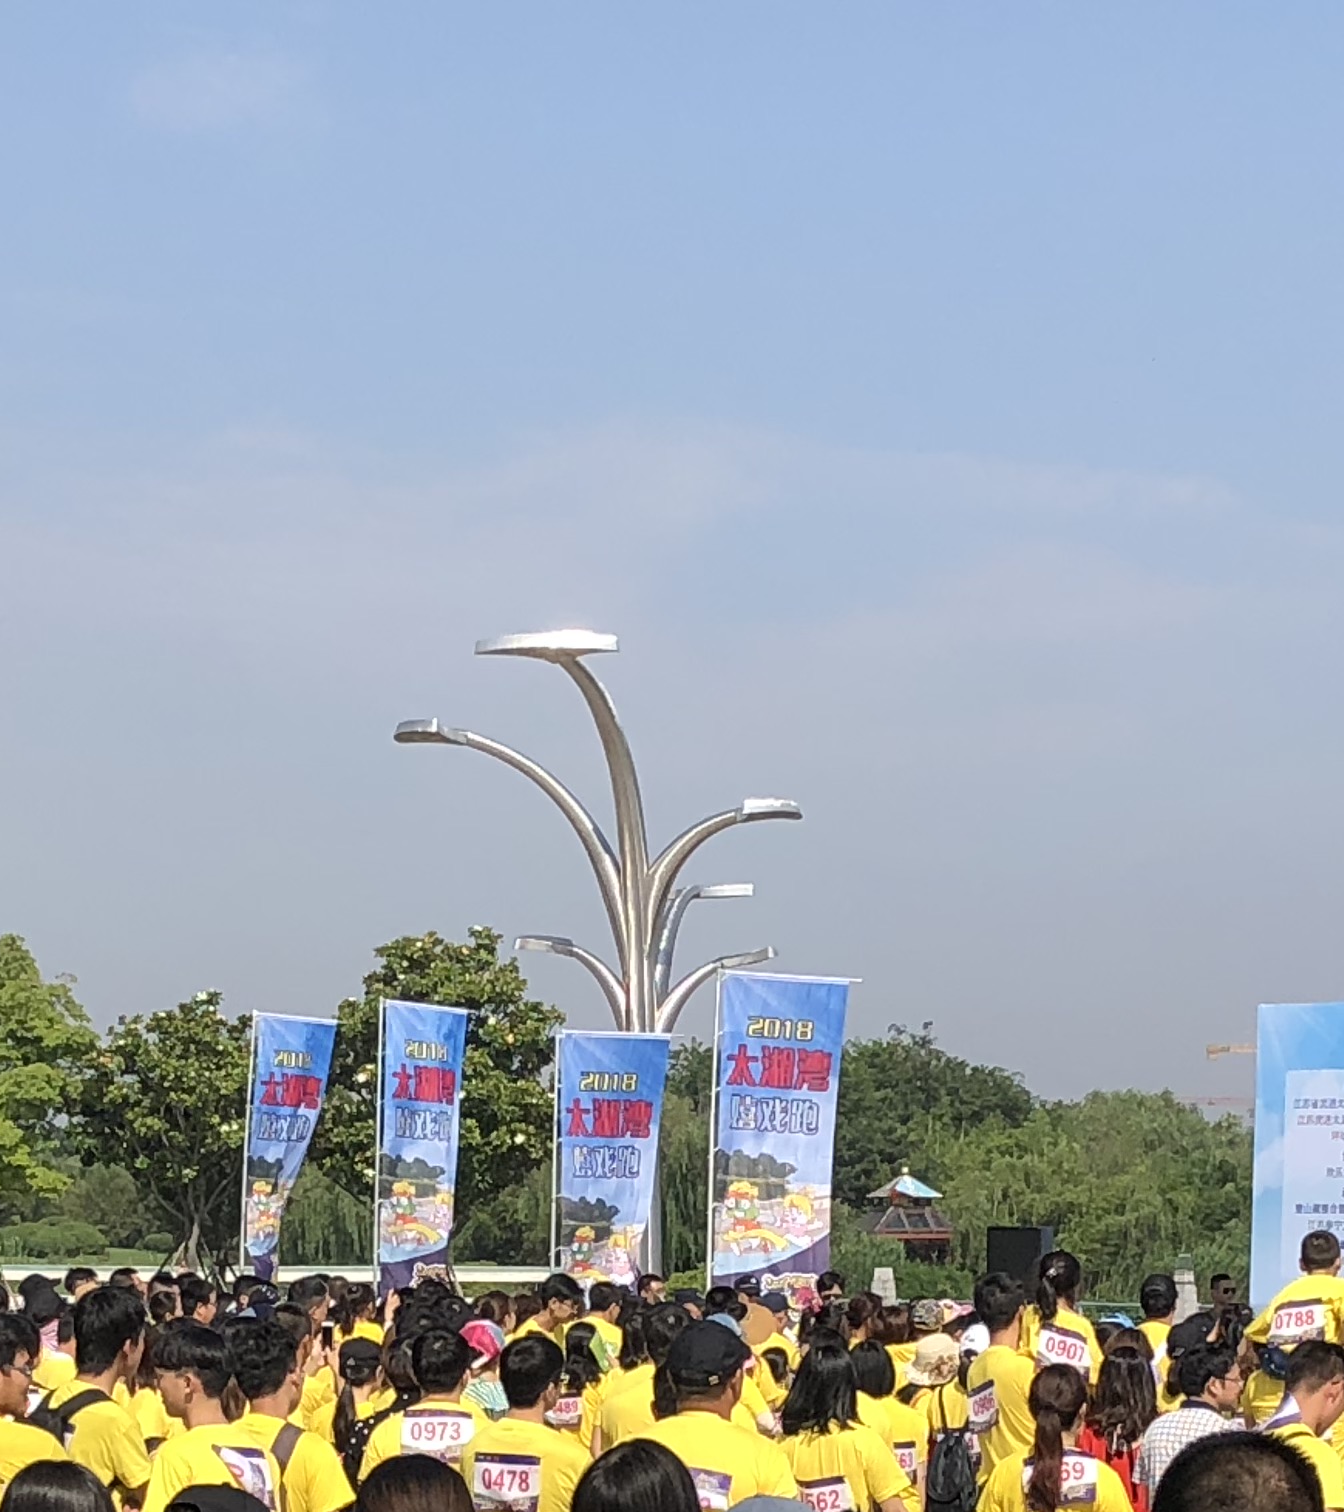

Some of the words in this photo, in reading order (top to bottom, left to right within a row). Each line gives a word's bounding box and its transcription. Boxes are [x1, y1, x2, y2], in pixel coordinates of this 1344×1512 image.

[747, 1016, 814, 1041] 2018
[726, 1044, 832, 1092] 太湖湾
[392, 1063, 456, 1106] 太湖湾
[579, 1071, 639, 1093] 2018
[565, 1098, 654, 1139] 太湖湾
[1275, 1309, 1315, 1330] 0788
[1045, 1336, 1085, 1363] 0907
[410, 1421, 462, 1442] 0973
[482, 1468, 531, 1493] 0478
[1060, 1461, 1085, 1482] 69
[799, 1489, 842, 1511] 562
